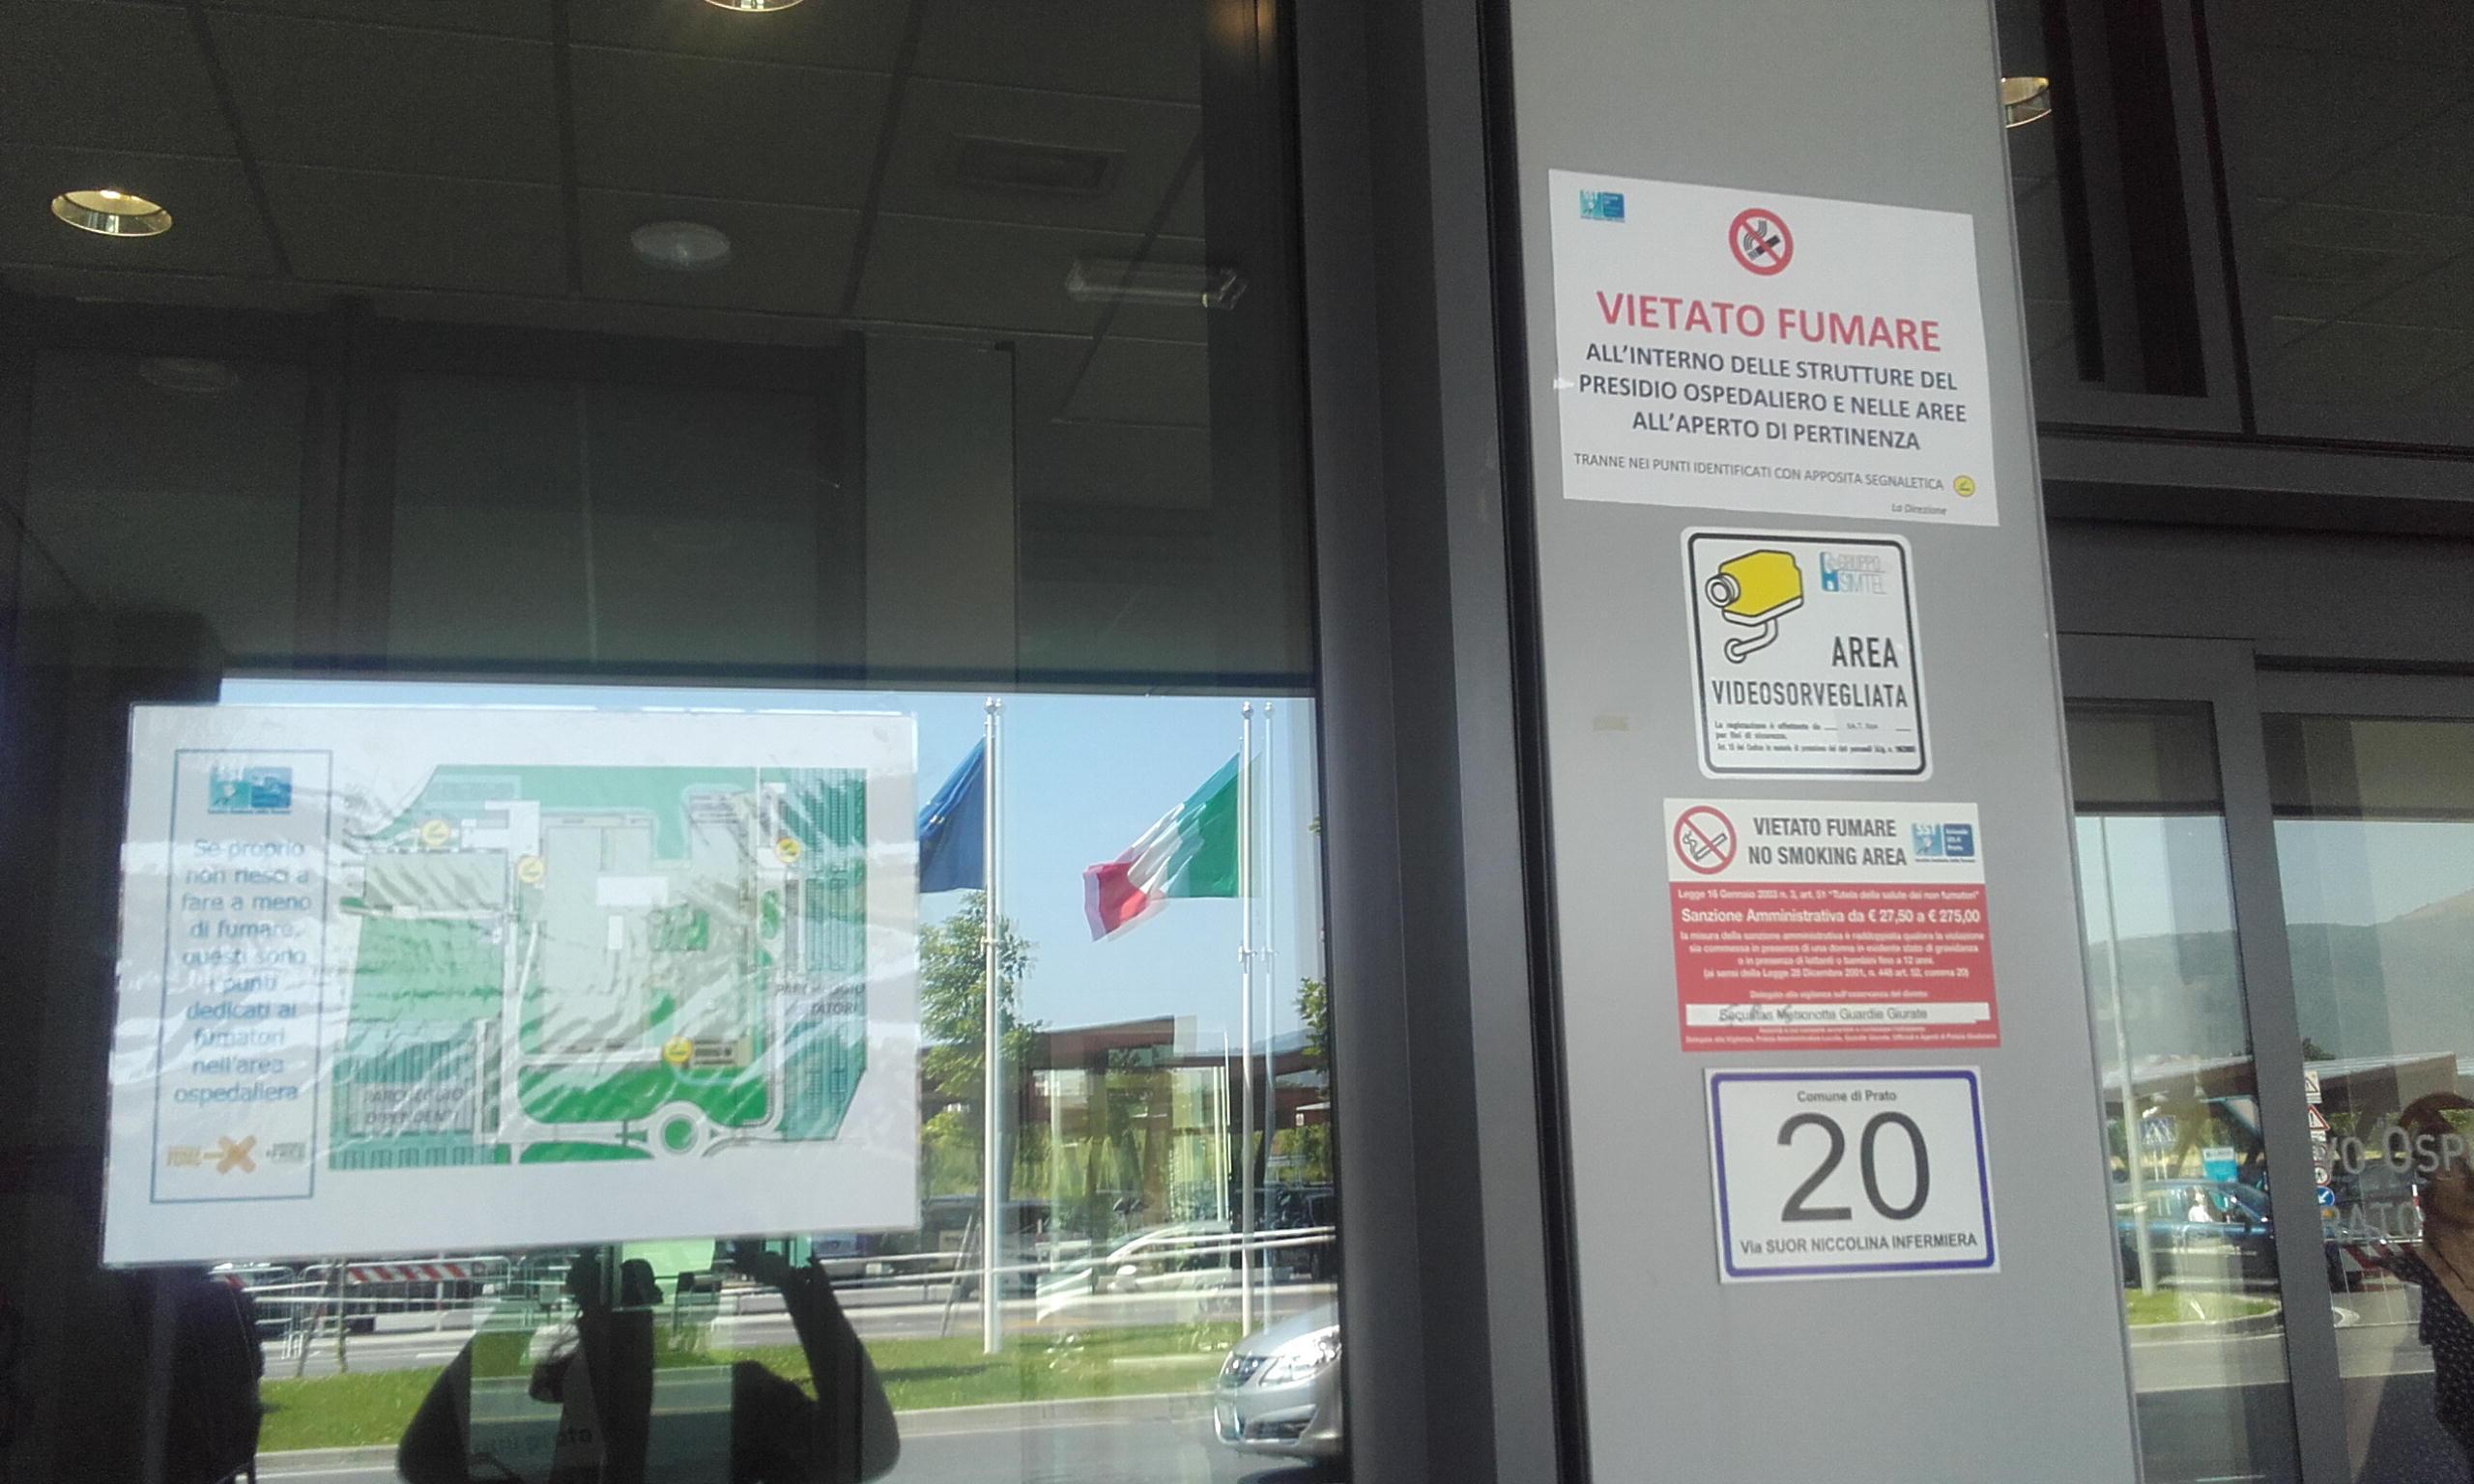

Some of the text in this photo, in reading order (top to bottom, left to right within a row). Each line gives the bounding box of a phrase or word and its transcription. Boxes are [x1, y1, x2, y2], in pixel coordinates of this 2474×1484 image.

[1596, 290, 1942, 353] VIETATO FUMARE
[1585, 342, 1958, 391] ALL'INTERNO DELLE STRUTTURE DEL
[1579, 374, 1968, 423] PRESIDIO OSPEDALIERO E NELLE AREE
[1631, 411, 1921, 451] ALL'APERTO DI PERTINENZA
[1573, 452, 1945, 491] TRANNE NEI PUNTI IDENTIFICATI CON APPOSITA SEGNALETICA
[1904, 503, 1948, 516] Direzione
[1831, 636, 1900, 669] AREA
[1712, 679, 1909, 708] VIDEOSORVEGLIATA
[1753, 817, 1897, 838] VIETATO FUMARE
[193, 838, 305, 860] Se proprio
[1748, 845, 1908, 866] NO SMOKING AREA
[185, 870, 226, 885] non
[296, 870, 310, 884] a
[182, 892, 313, 911] fare a meno
[1682, 908, 1980, 924] Sanzione Amministrativa da € 27,50 a € 275,00
[189, 921, 209, 938] di
[186, 1002, 297, 1020] dedicati ai
[1839, 1007, 1884, 1019] Guardie
[1886, 1007, 1928, 1019] Giurate
[174, 1083, 299, 1107] ospedaliera
[1797, 1090, 1897, 1102] Comune di Prato
[1776, 1111, 1931, 1222] 20
[1740, 1233, 1978, 1255] Via SUOR NICCOLINA INFERMIERA
